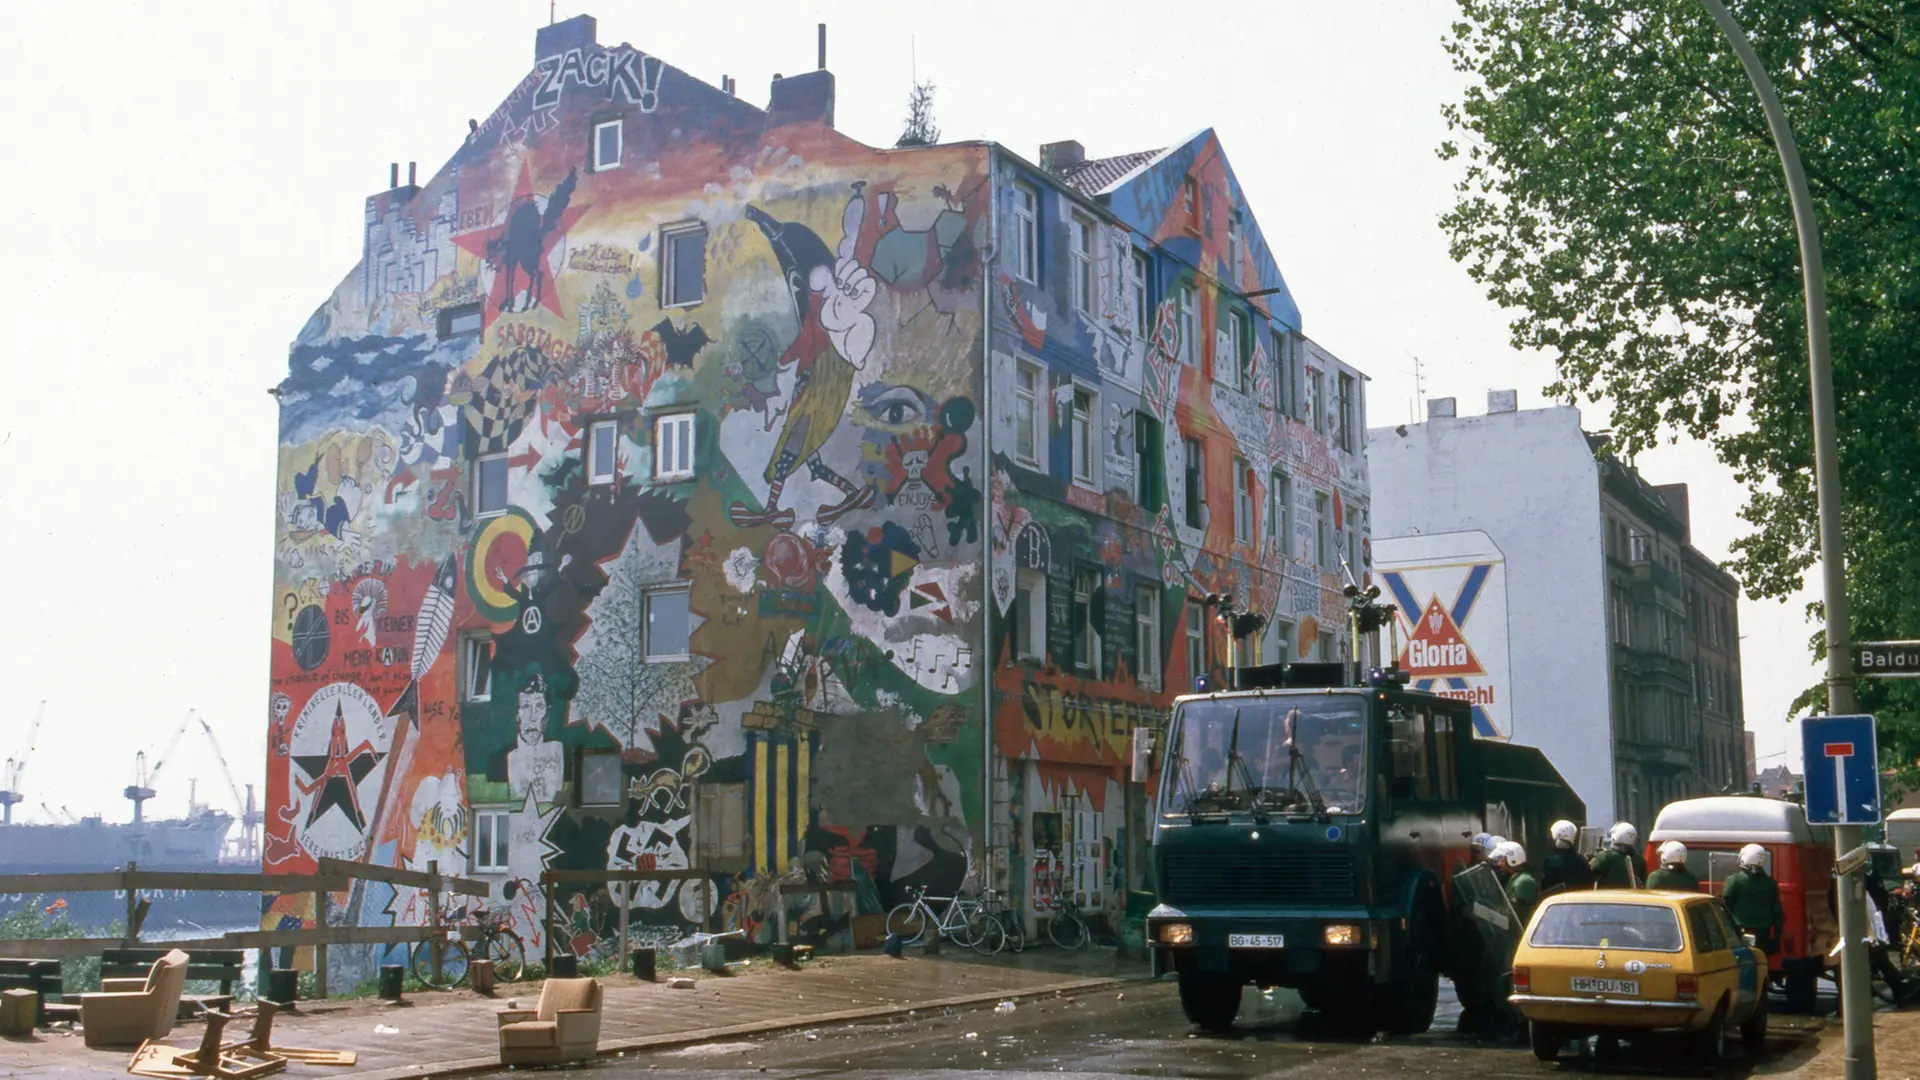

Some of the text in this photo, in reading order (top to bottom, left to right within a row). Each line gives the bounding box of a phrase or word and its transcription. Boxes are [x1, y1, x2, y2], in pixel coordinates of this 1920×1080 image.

[533, 48, 665, 113] ZACK!
[1408, 637, 1468, 668] Gloria
[1861, 651, 1919, 667] Baldu
